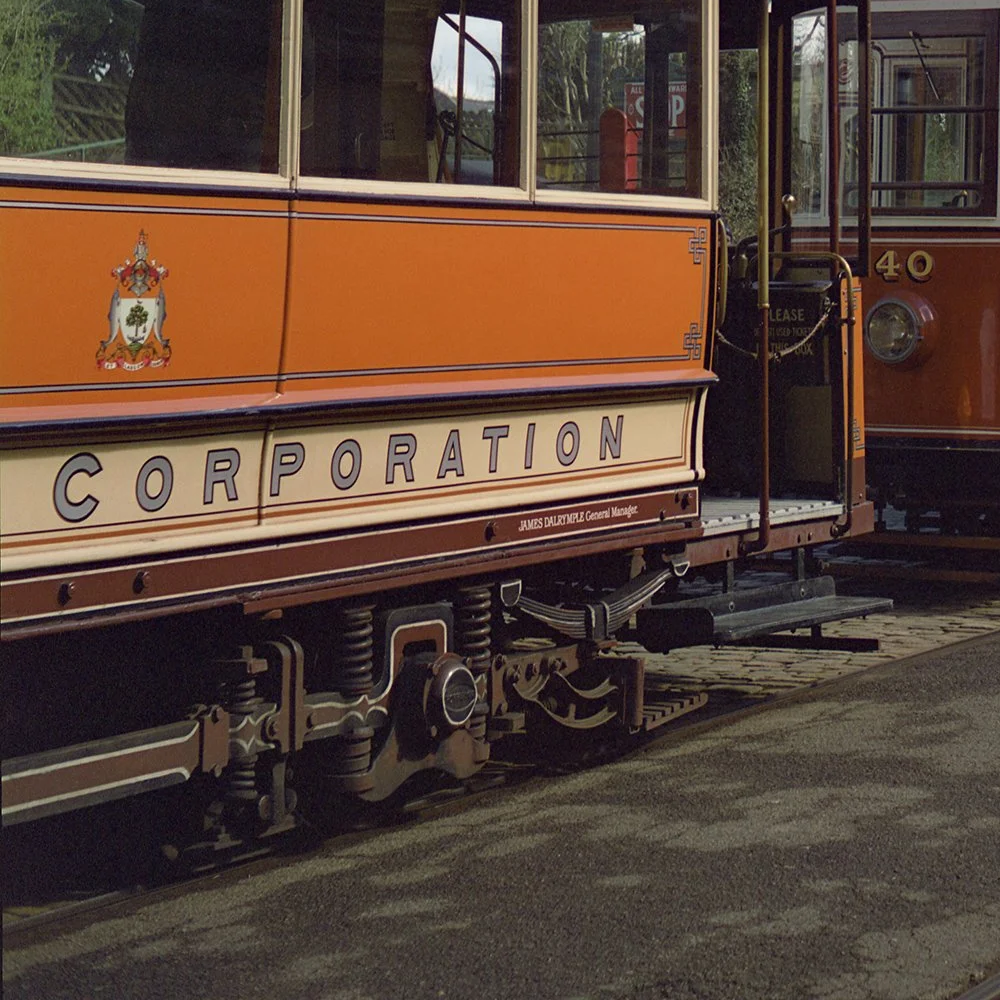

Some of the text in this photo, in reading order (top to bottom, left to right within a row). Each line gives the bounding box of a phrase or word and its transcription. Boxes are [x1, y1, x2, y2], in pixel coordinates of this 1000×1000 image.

[631, 86, 642, 94] ALL
[875, 250, 934, 281] 40
[769, 308, 805, 321] LEASE
[53, 415, 625, 522] CORPORATION
[518, 517, 543, 531] JAMES
[544, 511, 584, 528] DALRYMPLE
[585, 508, 610, 521] General
